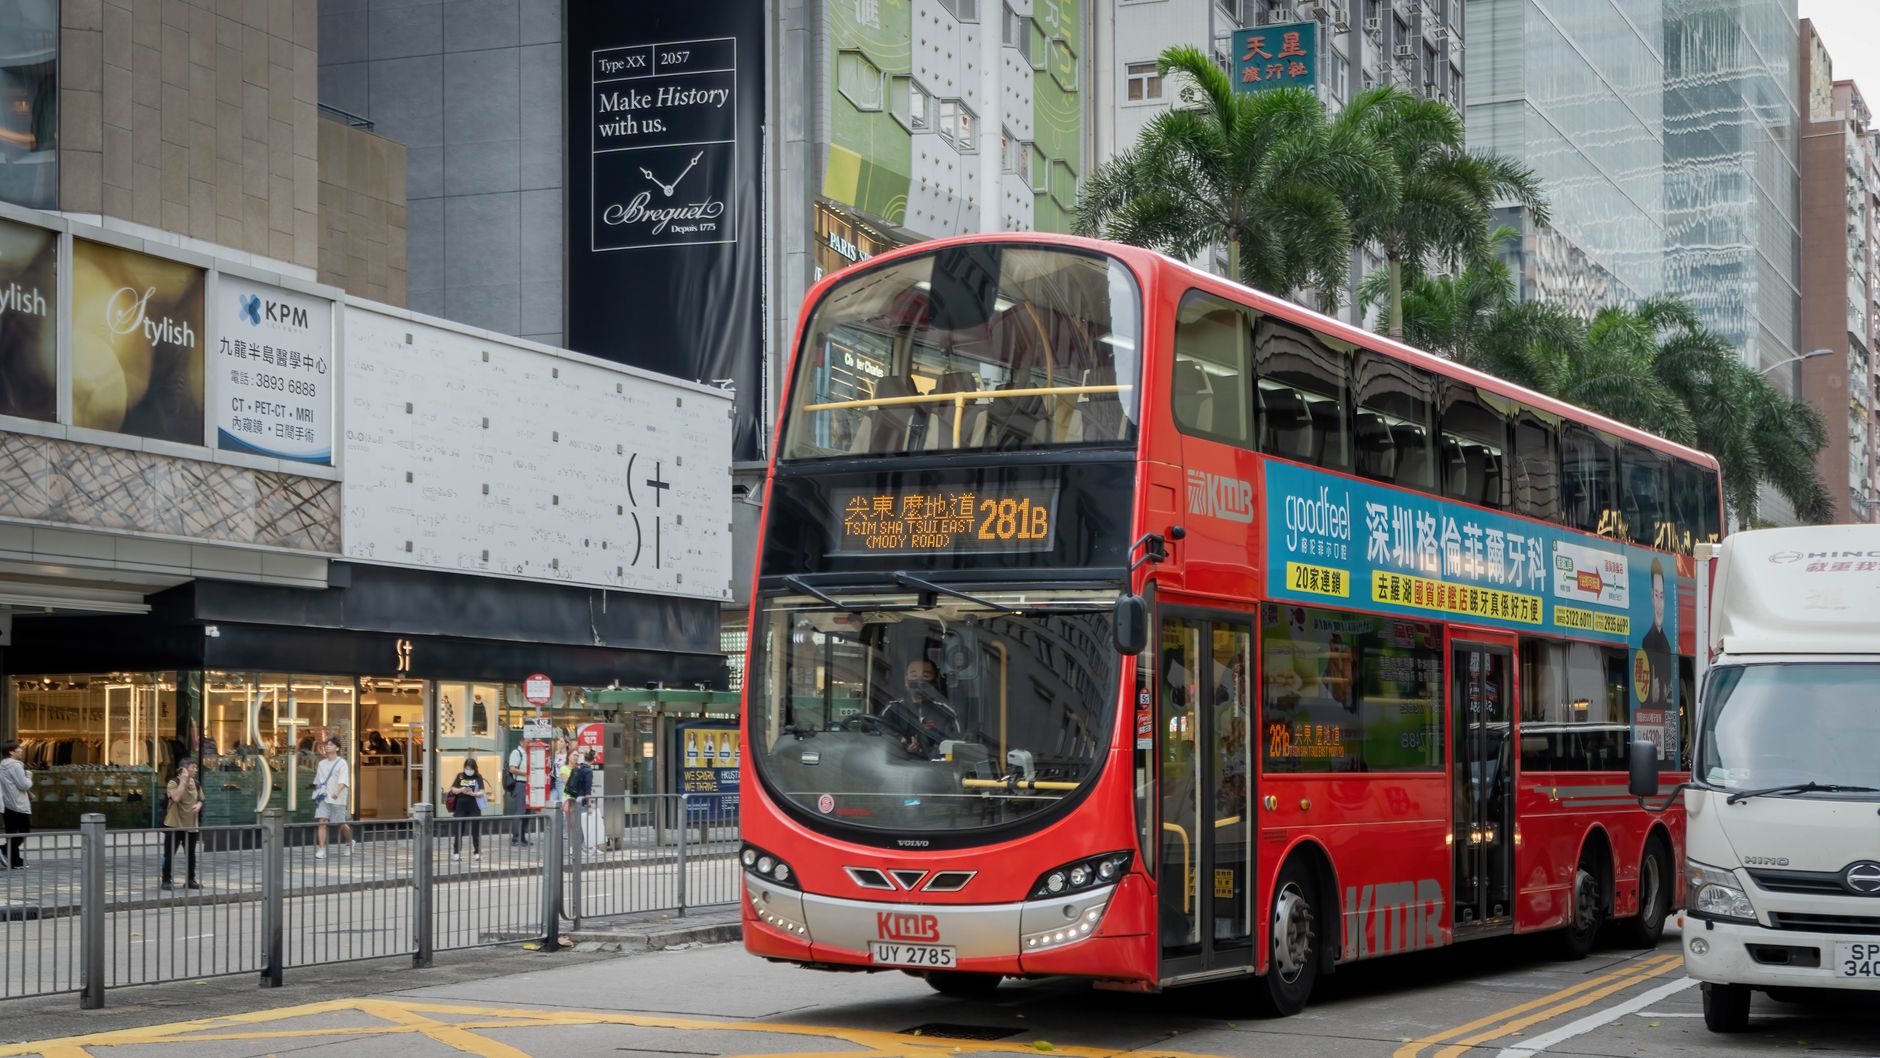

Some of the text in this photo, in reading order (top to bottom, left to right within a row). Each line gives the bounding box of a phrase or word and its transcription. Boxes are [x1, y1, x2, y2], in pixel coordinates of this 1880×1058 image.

[660, 52, 690, 65] 2057
[1242, 31, 1307, 61] 天星
[599, 55, 646, 73] Type XX
[1241, 61, 1308, 84] 旅行社
[599, 87, 729, 112] Make History
[599, 114, 667, 137] with us.
[603, 190, 724, 235] Breguet
[671, 223, 716, 234] Depuis 1775
[829, 231, 857, 262] PARIS
[106, 286, 195, 348] Stylish
[265, 300, 308, 329] KPM
[219, 336, 327, 374] 九龍半島醫學中心
[255, 372, 285, 391] 3893
[288, 379, 316, 397] 6888
[232, 397, 314, 423] CT PET-CT MRI
[845, 492, 975, 522] 尖東 麼地道
[1207, 473, 1254, 524] KMB
[844, 518, 975, 536] TSIM SHA TSUI EAST
[977, 498, 1049, 540] 281B
[1285, 485, 1351, 552] goodfeel
[865, 533, 951, 549] (MODY ROAD)
[1365, 500, 1547, 593] 深圳格倫菲爾牙科
[1295, 565, 1341, 595] 20家連鎖
[1565, 610, 1579, 626] 5122
[1580, 612, 1592, 628] 6011
[1604, 615, 1617, 631] 2935
[1616, 617, 1629, 633] 6699
[897, 839, 930, 848] VOLVO
[1744, 855, 1790, 867] HINO
[877, 911, 940, 942] KMB
[1344, 879, 1446, 960] KMB
[878, 946, 952, 966] UY 2785
[1851, 944, 1880, 961] SP
